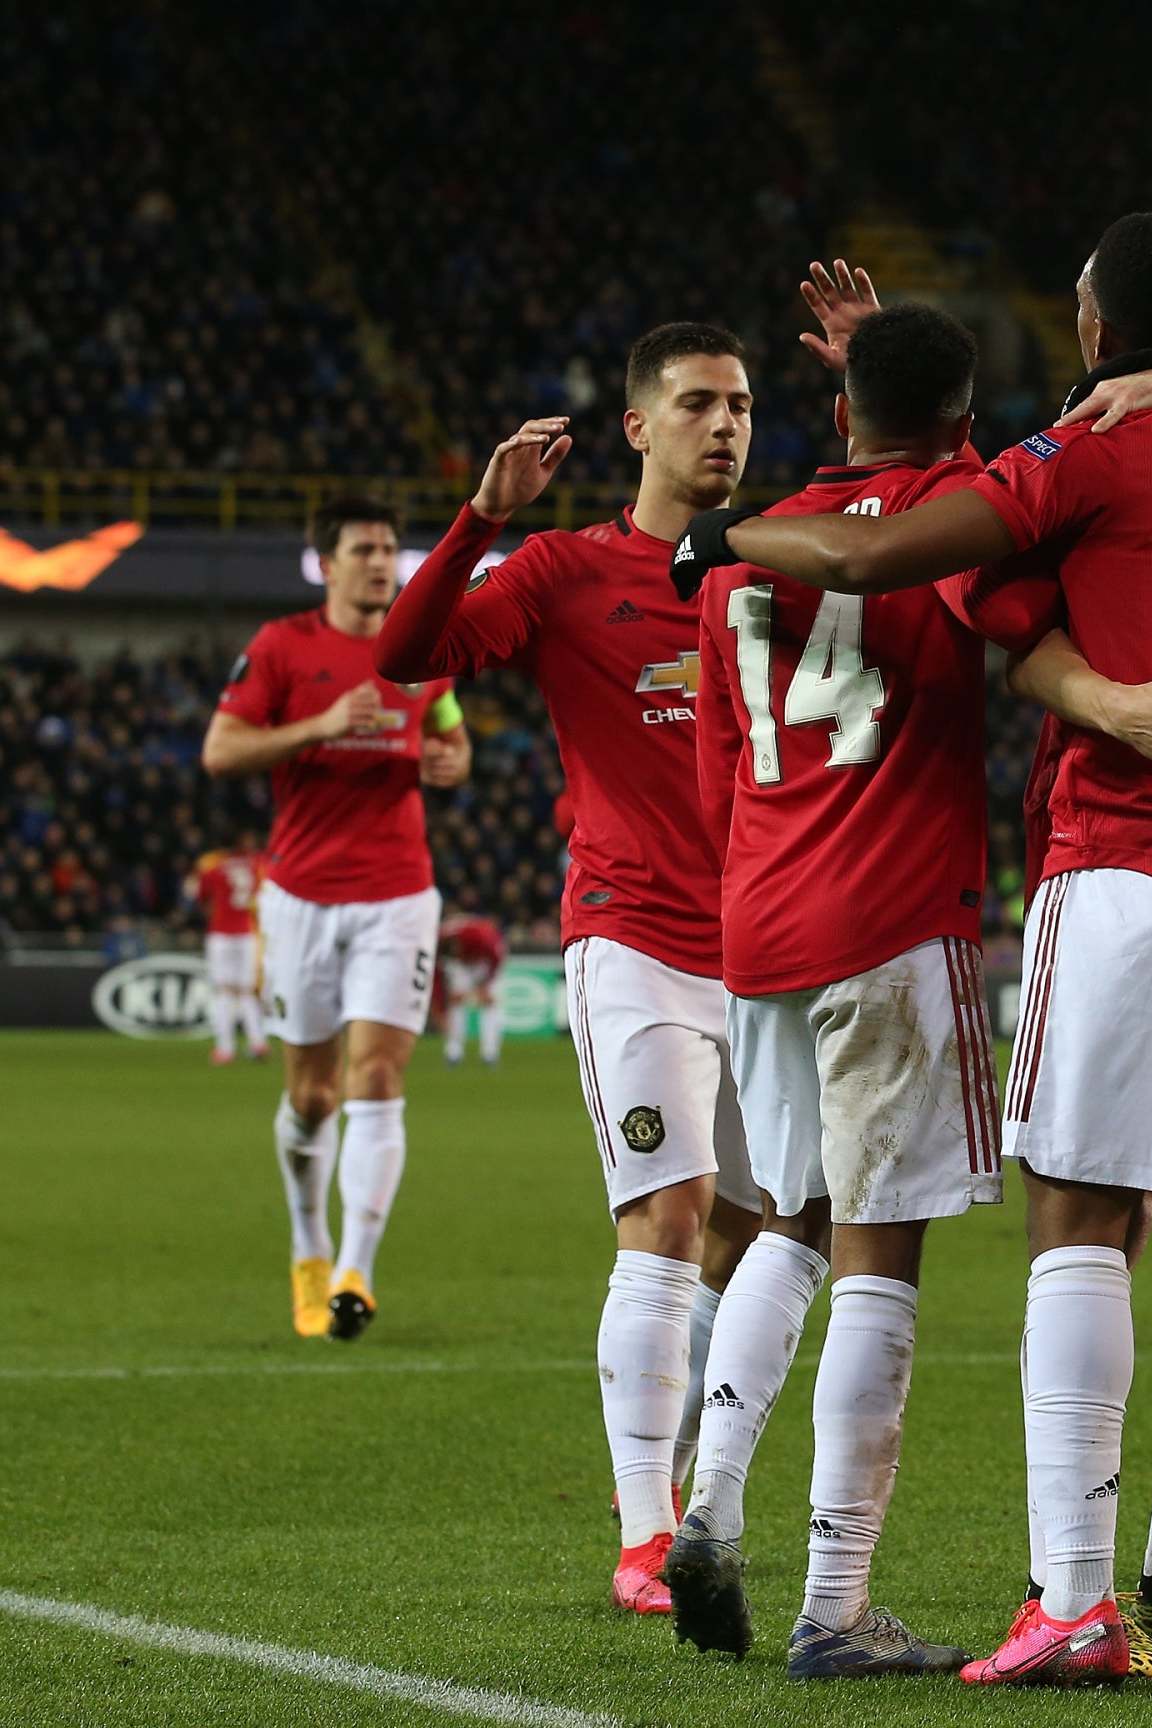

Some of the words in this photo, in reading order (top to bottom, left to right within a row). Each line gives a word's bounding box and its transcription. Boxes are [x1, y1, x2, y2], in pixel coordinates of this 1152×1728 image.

[606, 613, 645, 625] adidas
[727, 584, 885, 784] 14
[412, 949, 428, 991] 5
